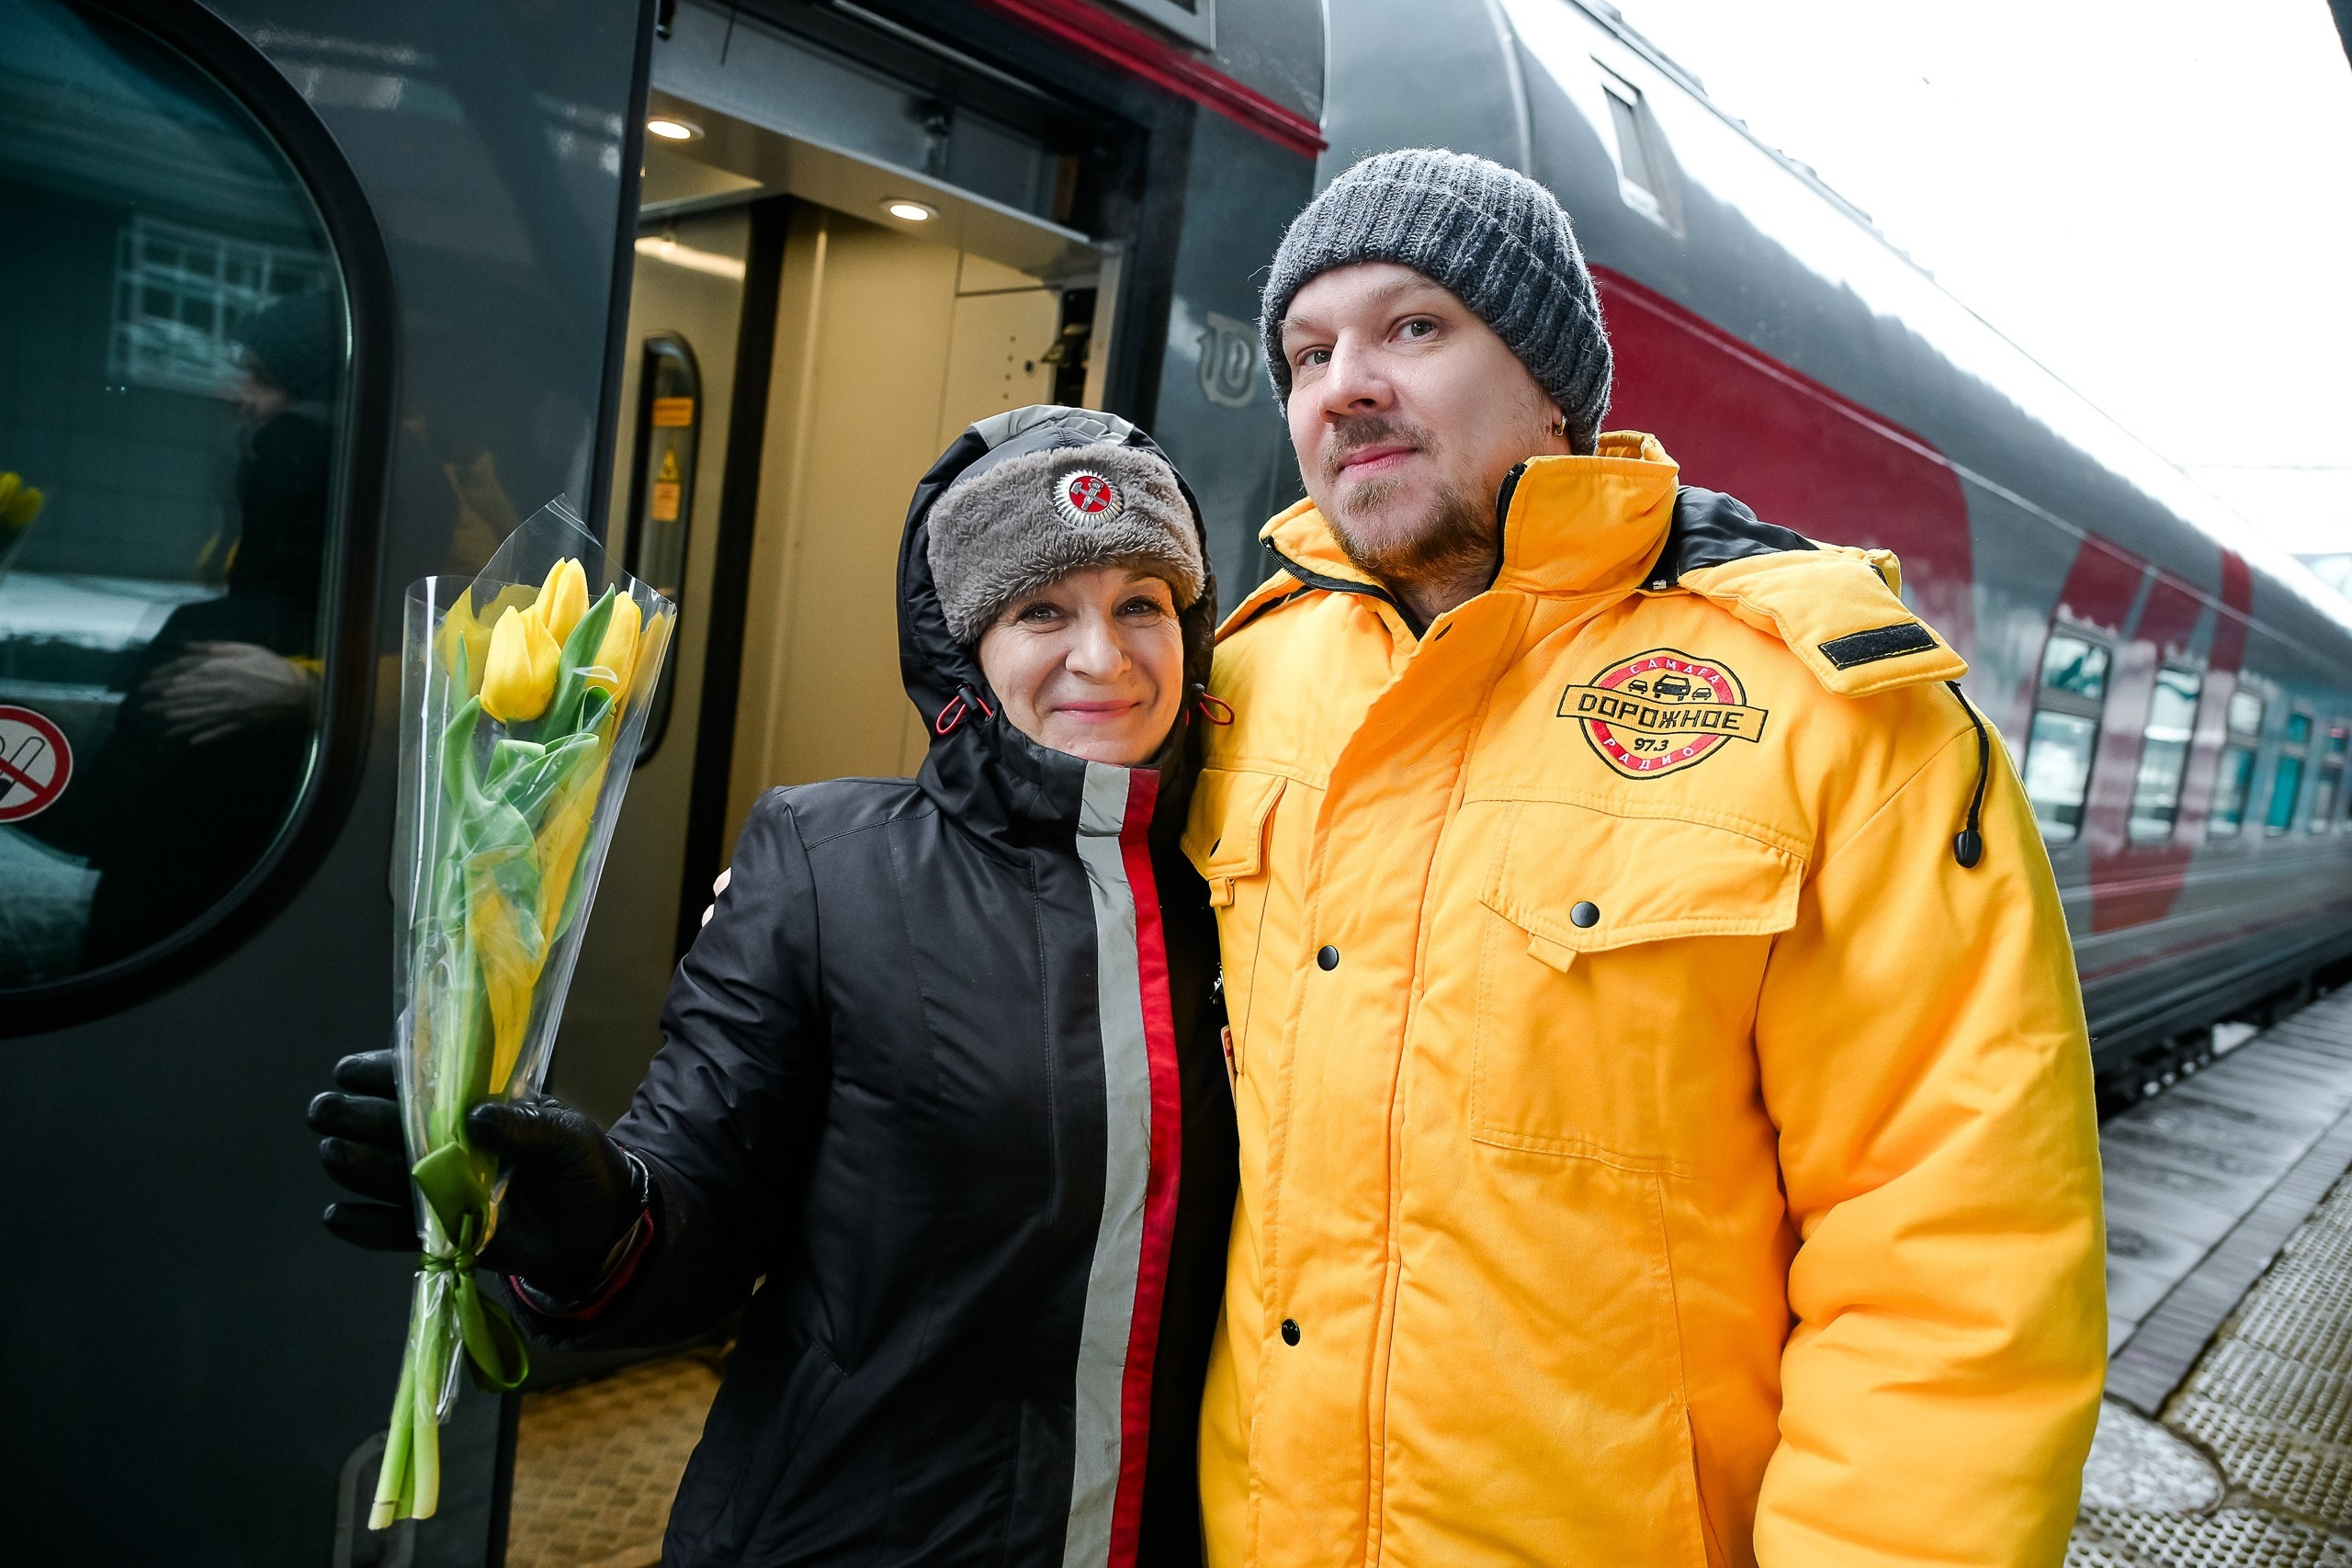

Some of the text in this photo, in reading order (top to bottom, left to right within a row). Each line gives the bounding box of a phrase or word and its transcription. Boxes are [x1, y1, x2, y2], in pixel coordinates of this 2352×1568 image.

[1630, 659, 1721, 683] САМАРА
[1603, 738, 1694, 771] РАДИО
[1634, 738, 1669, 751] 97.3
